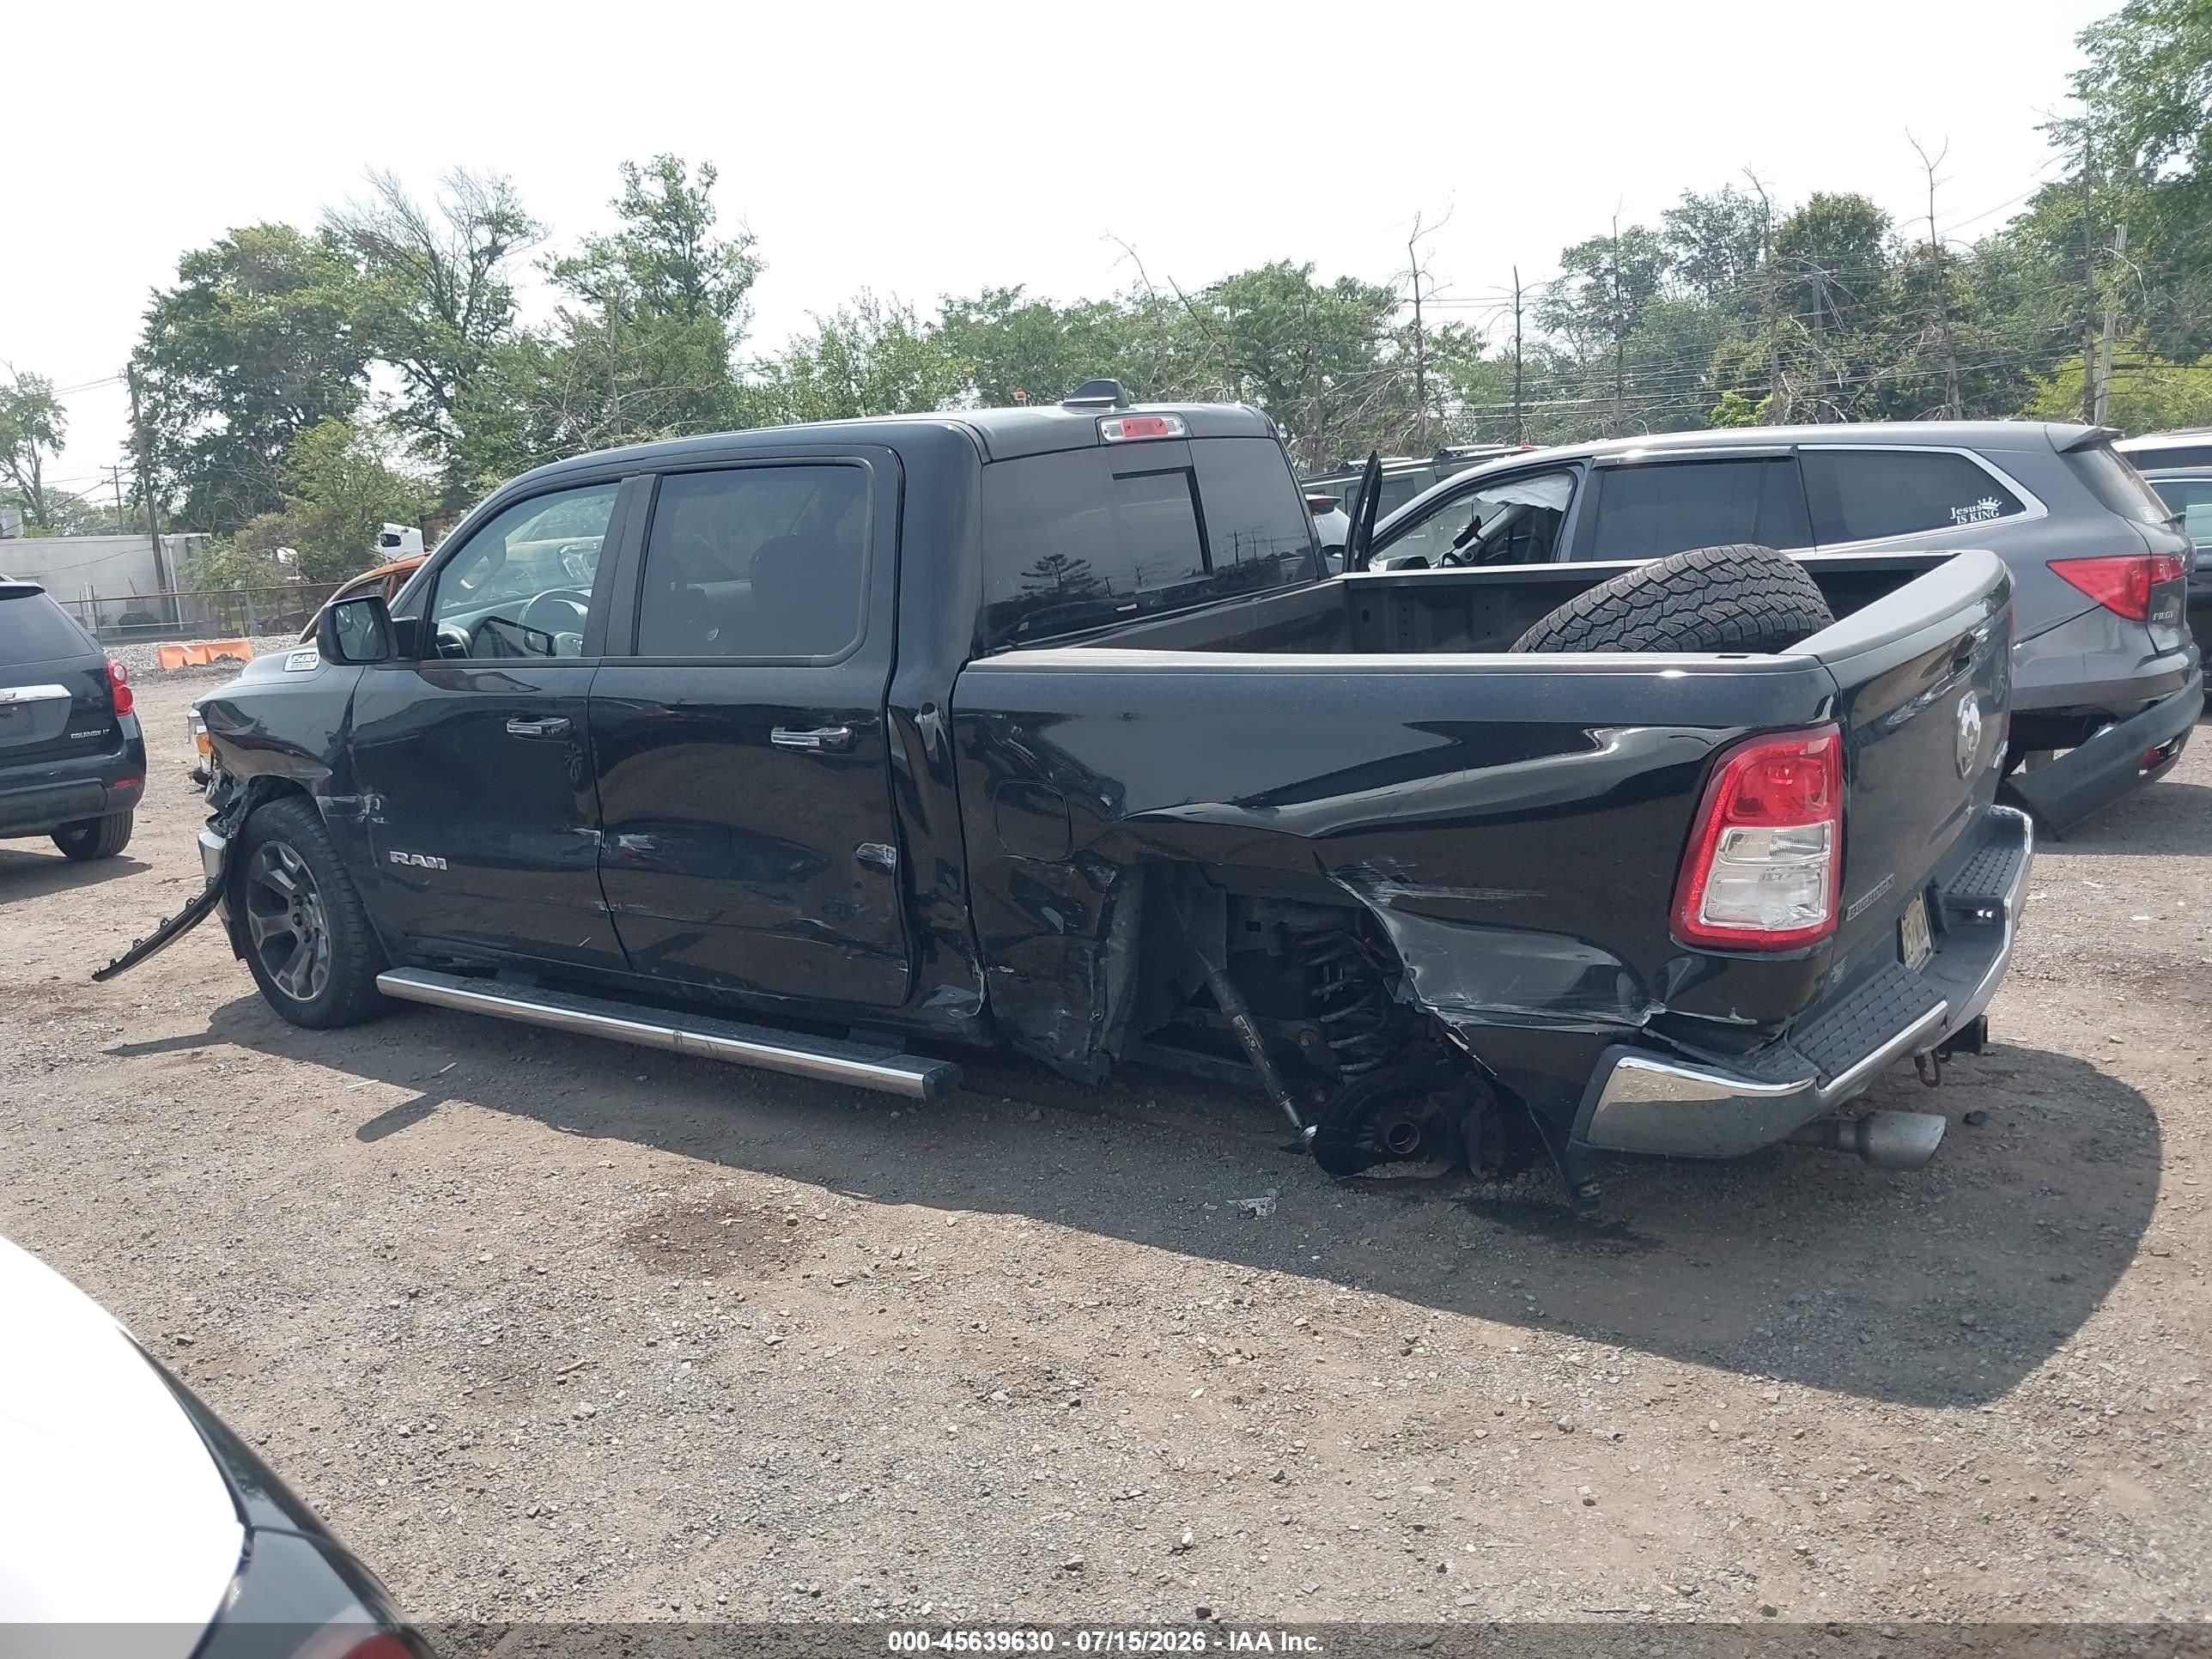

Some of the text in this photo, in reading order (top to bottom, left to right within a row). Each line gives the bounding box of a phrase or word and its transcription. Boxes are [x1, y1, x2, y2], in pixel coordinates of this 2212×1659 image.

[1949, 505, 1982, 520] Jesus
[1957, 508, 1999, 525] IS KING
[389, 851, 447, 871] RAM
